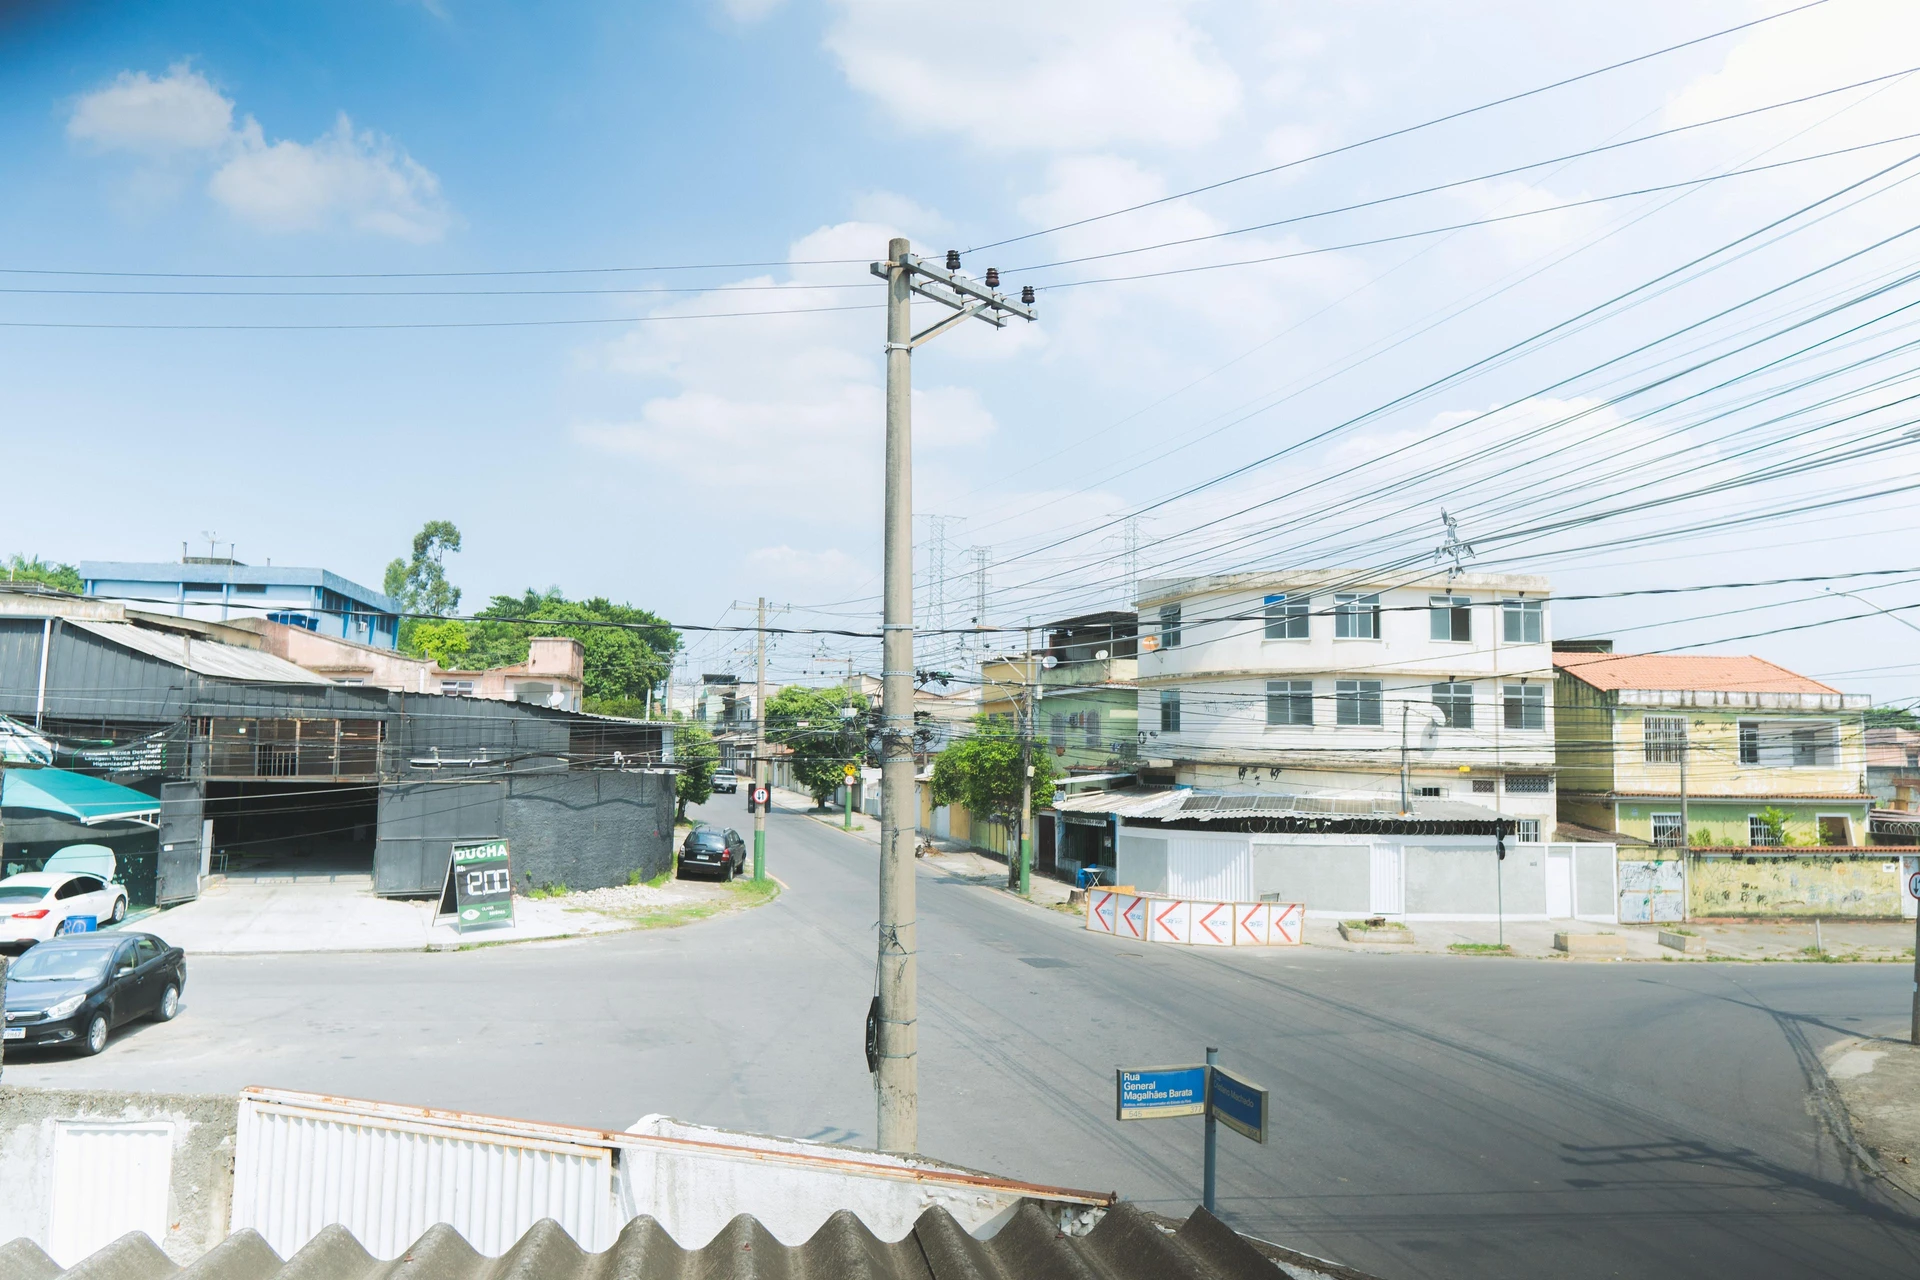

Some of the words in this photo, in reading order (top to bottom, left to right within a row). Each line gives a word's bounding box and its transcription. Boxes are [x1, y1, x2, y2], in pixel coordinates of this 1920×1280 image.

[454, 844, 508, 861] DUCHA
[467, 869, 511, 896] 2,00
[1123, 1072, 1140, 1081] Rua
[1123, 1081, 1156, 1091] General
[1123, 1090, 1168, 1101] Magalhães
[1168, 1089, 1193, 1098] Barata
[1230, 1089, 1255, 1108] Machado
[1189, 1105, 1202, 1114] 377
